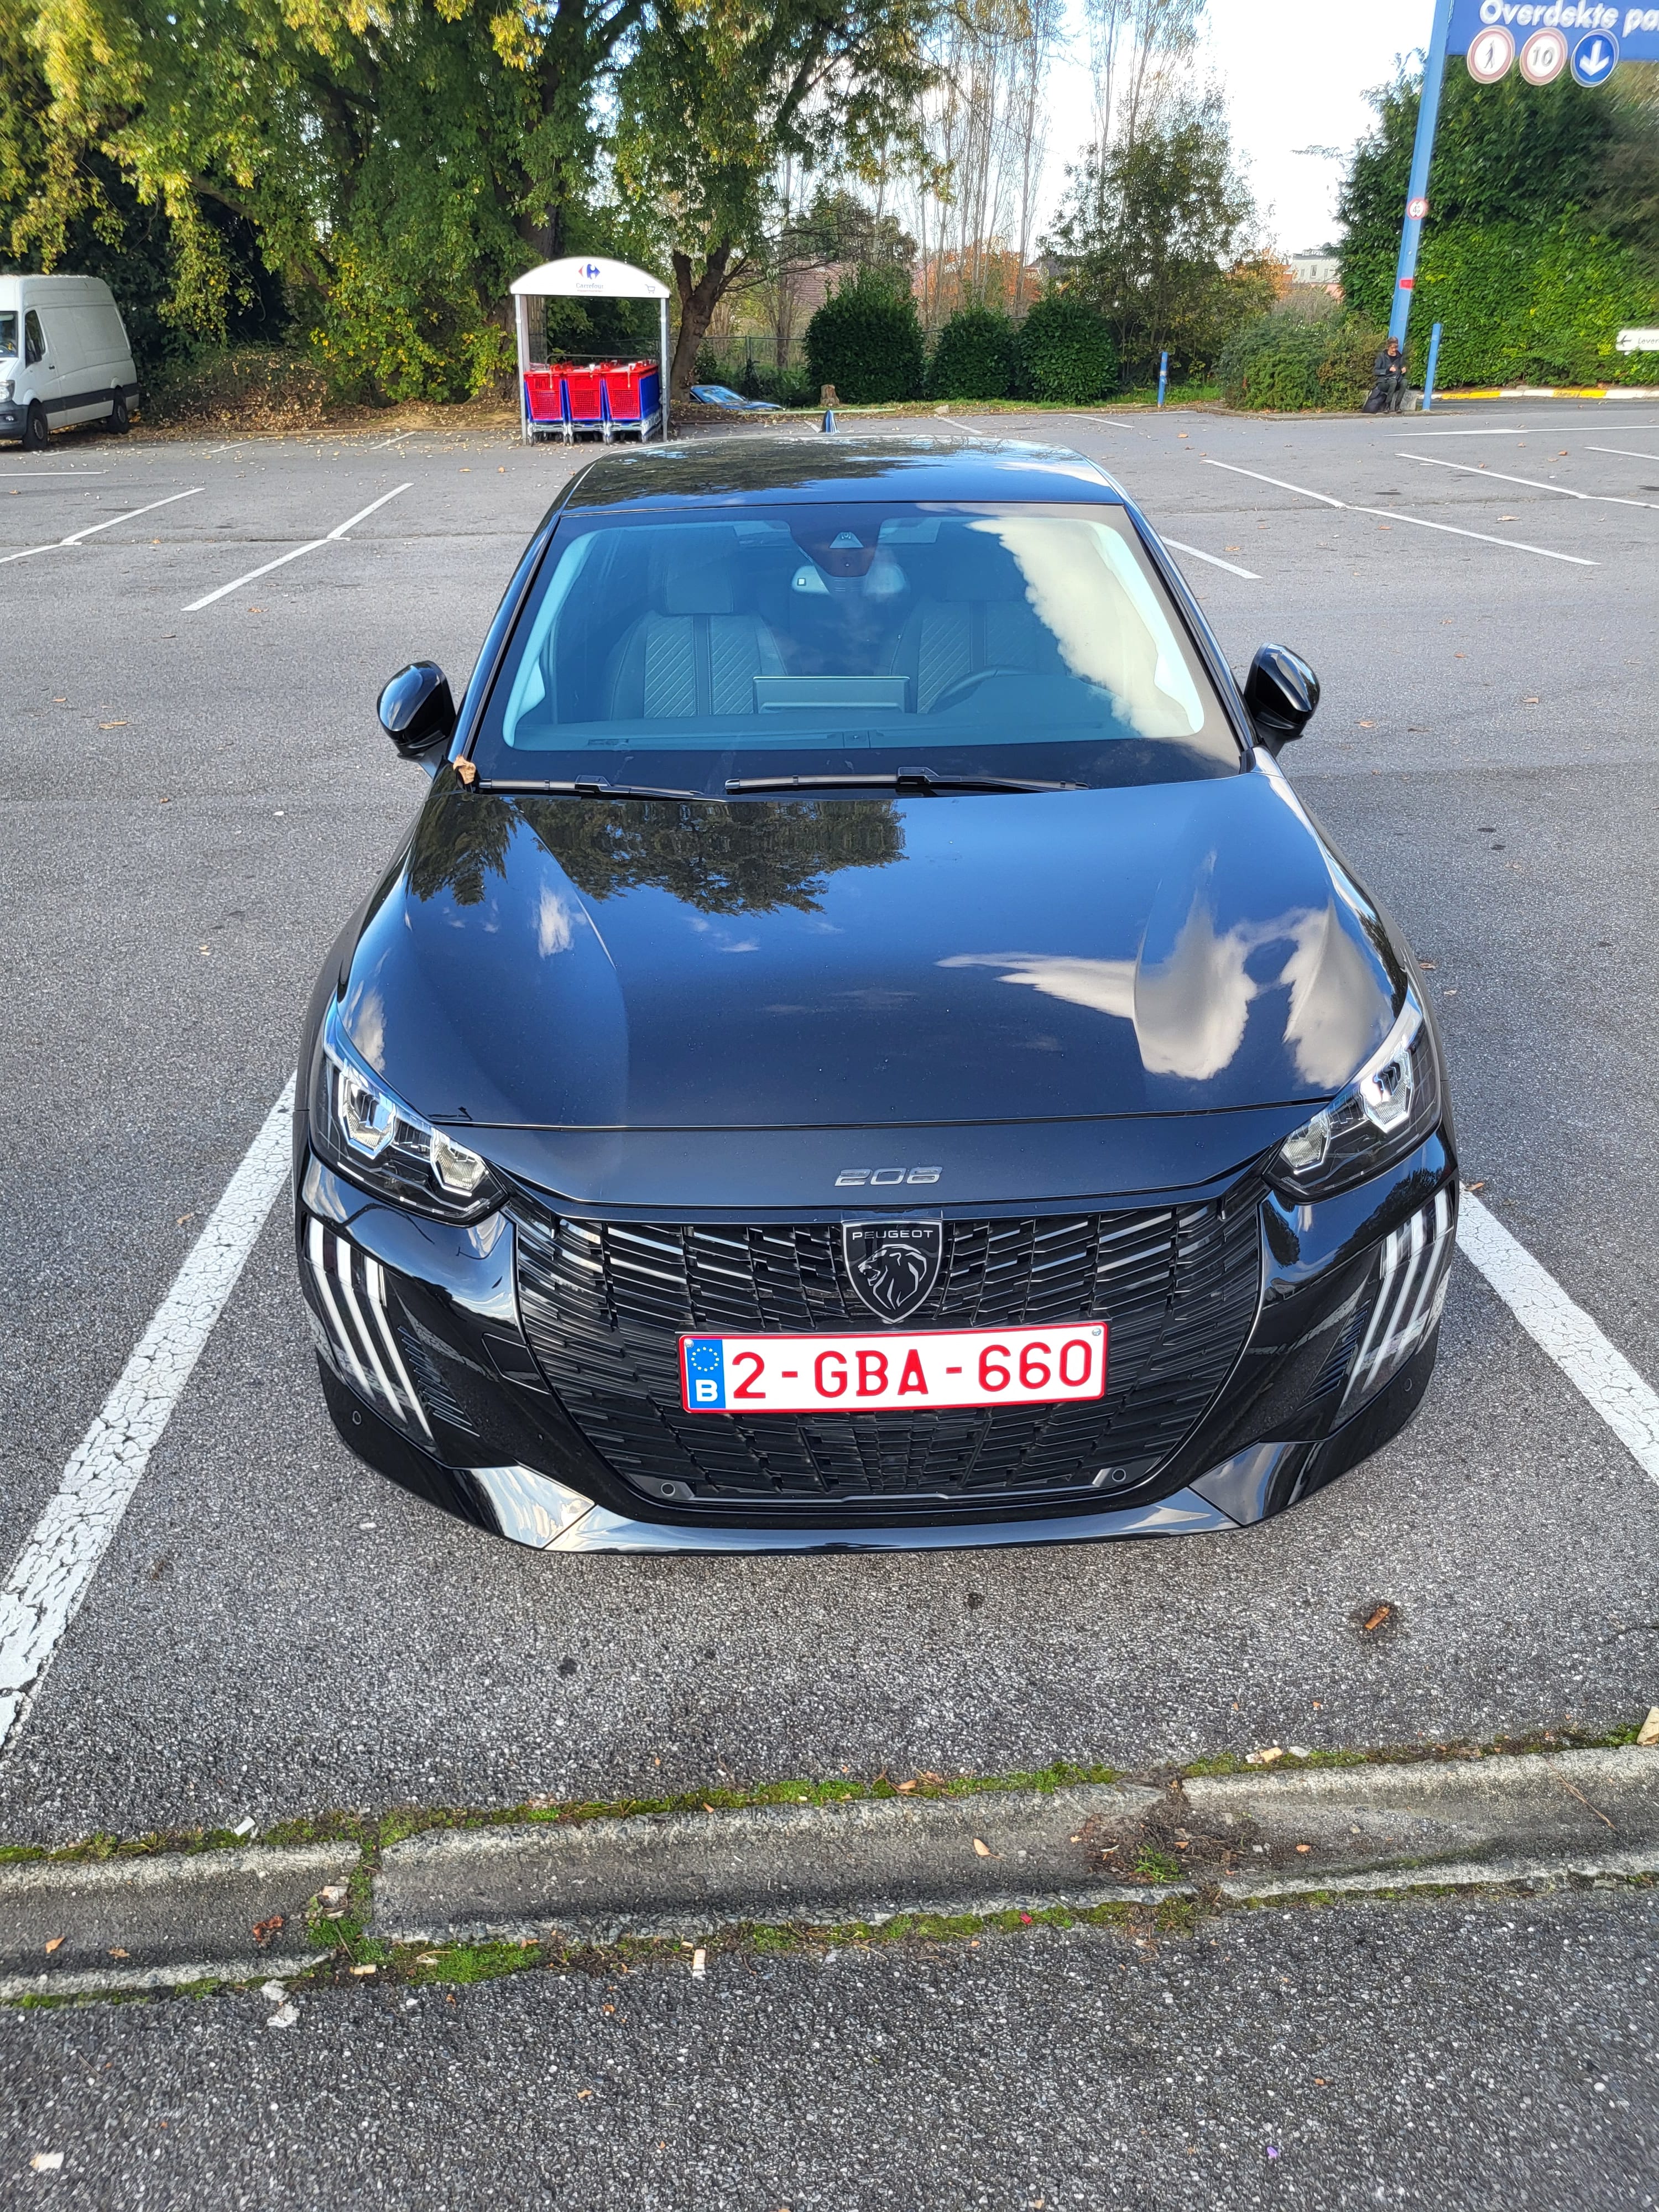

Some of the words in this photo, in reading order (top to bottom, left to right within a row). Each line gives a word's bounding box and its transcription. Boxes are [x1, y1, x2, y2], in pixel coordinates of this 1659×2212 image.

[1480, 0, 1619, 28] Overdekte
[1622, 8, 1659, 38] pa
[1532, 46, 1555, 67] 10
[834, 1167, 942, 1186] 208
[852, 1230, 933, 1240] PEUGEOT
[732, 1339, 1092, 1399] 2-GBA-660
[696, 1380, 718, 1402] B
